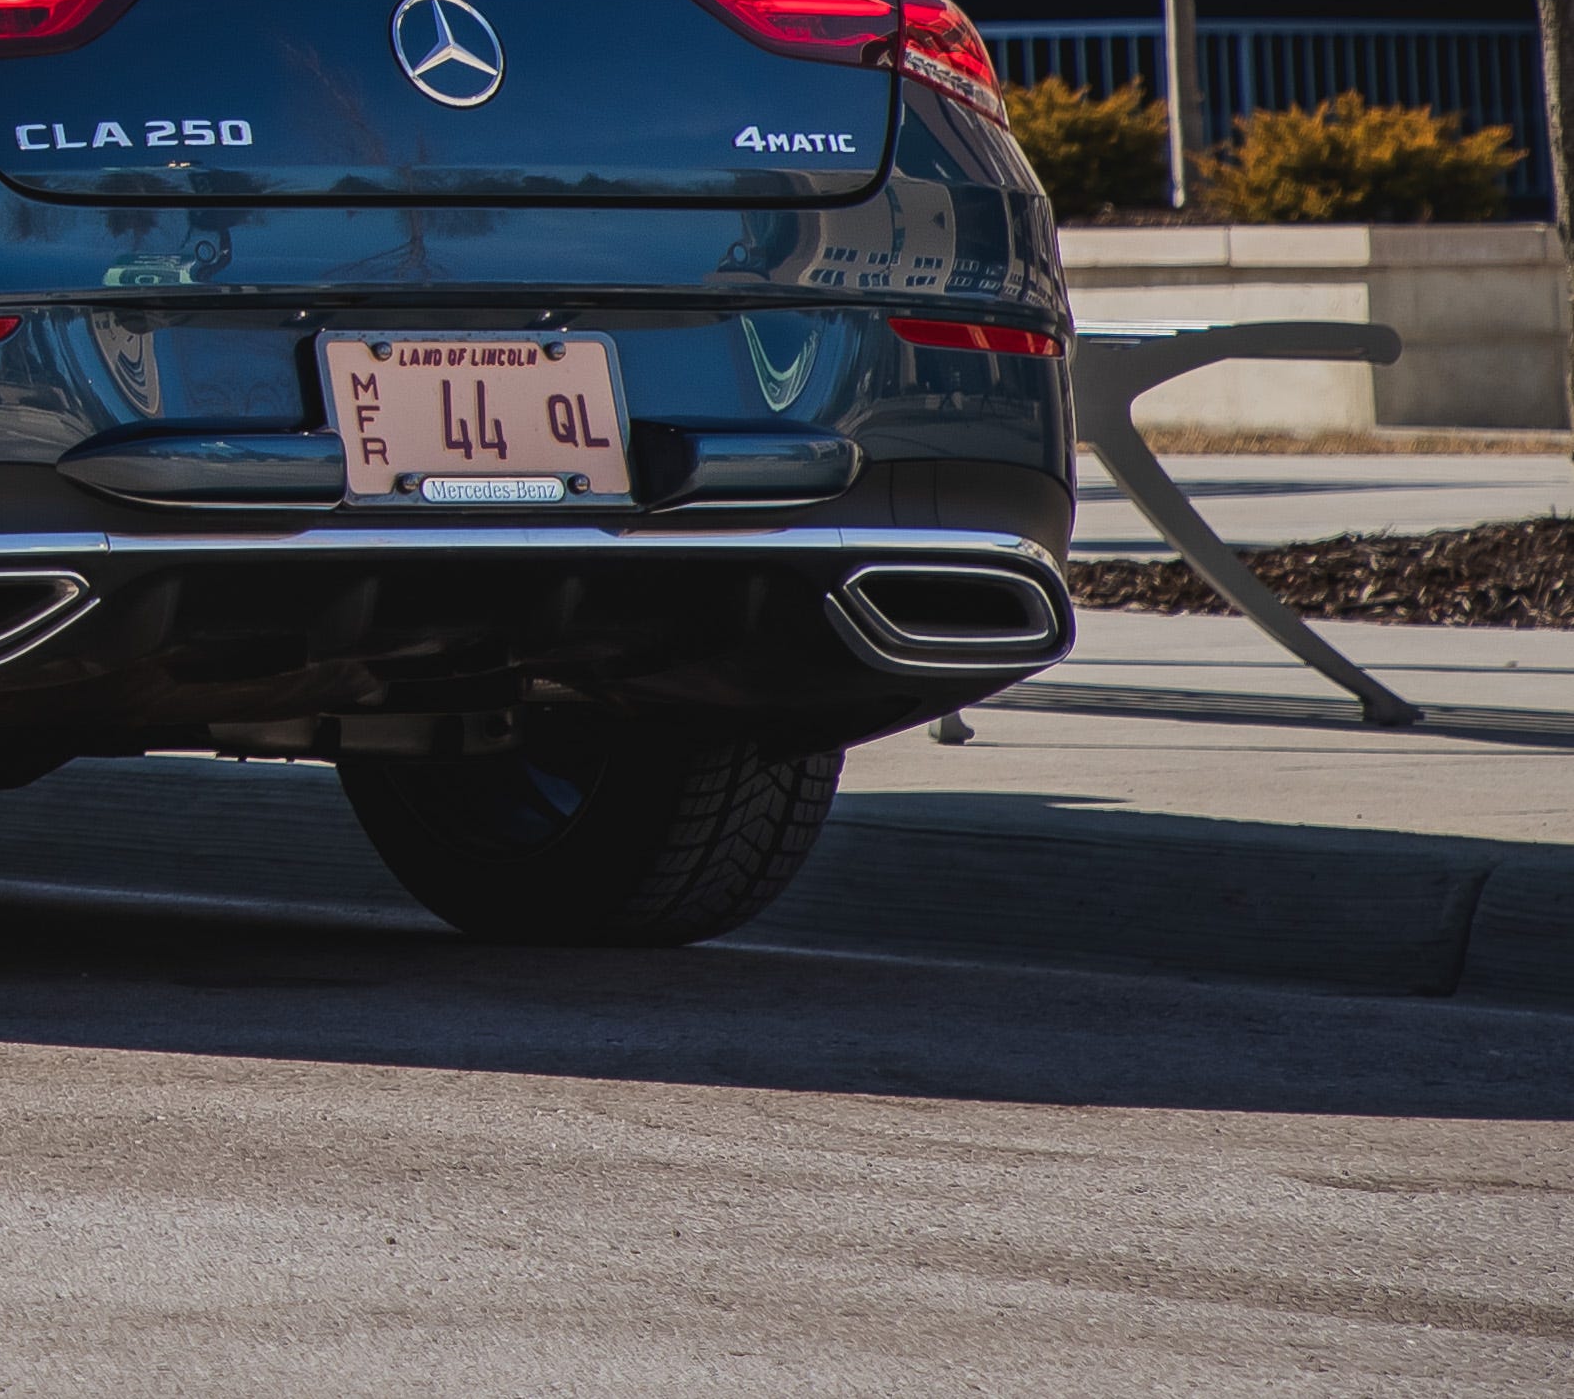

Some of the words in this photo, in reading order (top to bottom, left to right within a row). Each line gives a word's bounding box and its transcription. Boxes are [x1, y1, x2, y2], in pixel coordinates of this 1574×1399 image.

[15, 121, 134, 151] CLA
[145, 119, 253, 147] 250
[734, 125, 856, 153] 4MATIC
[399, 348, 443, 367] LAND
[447, 348, 468, 367] OF
[470, 348, 538, 367] LINCOLN
[441, 379, 508, 460] 44
[547, 393, 611, 448] QL
[431, 480, 558, 500] Mercedes-Benz
